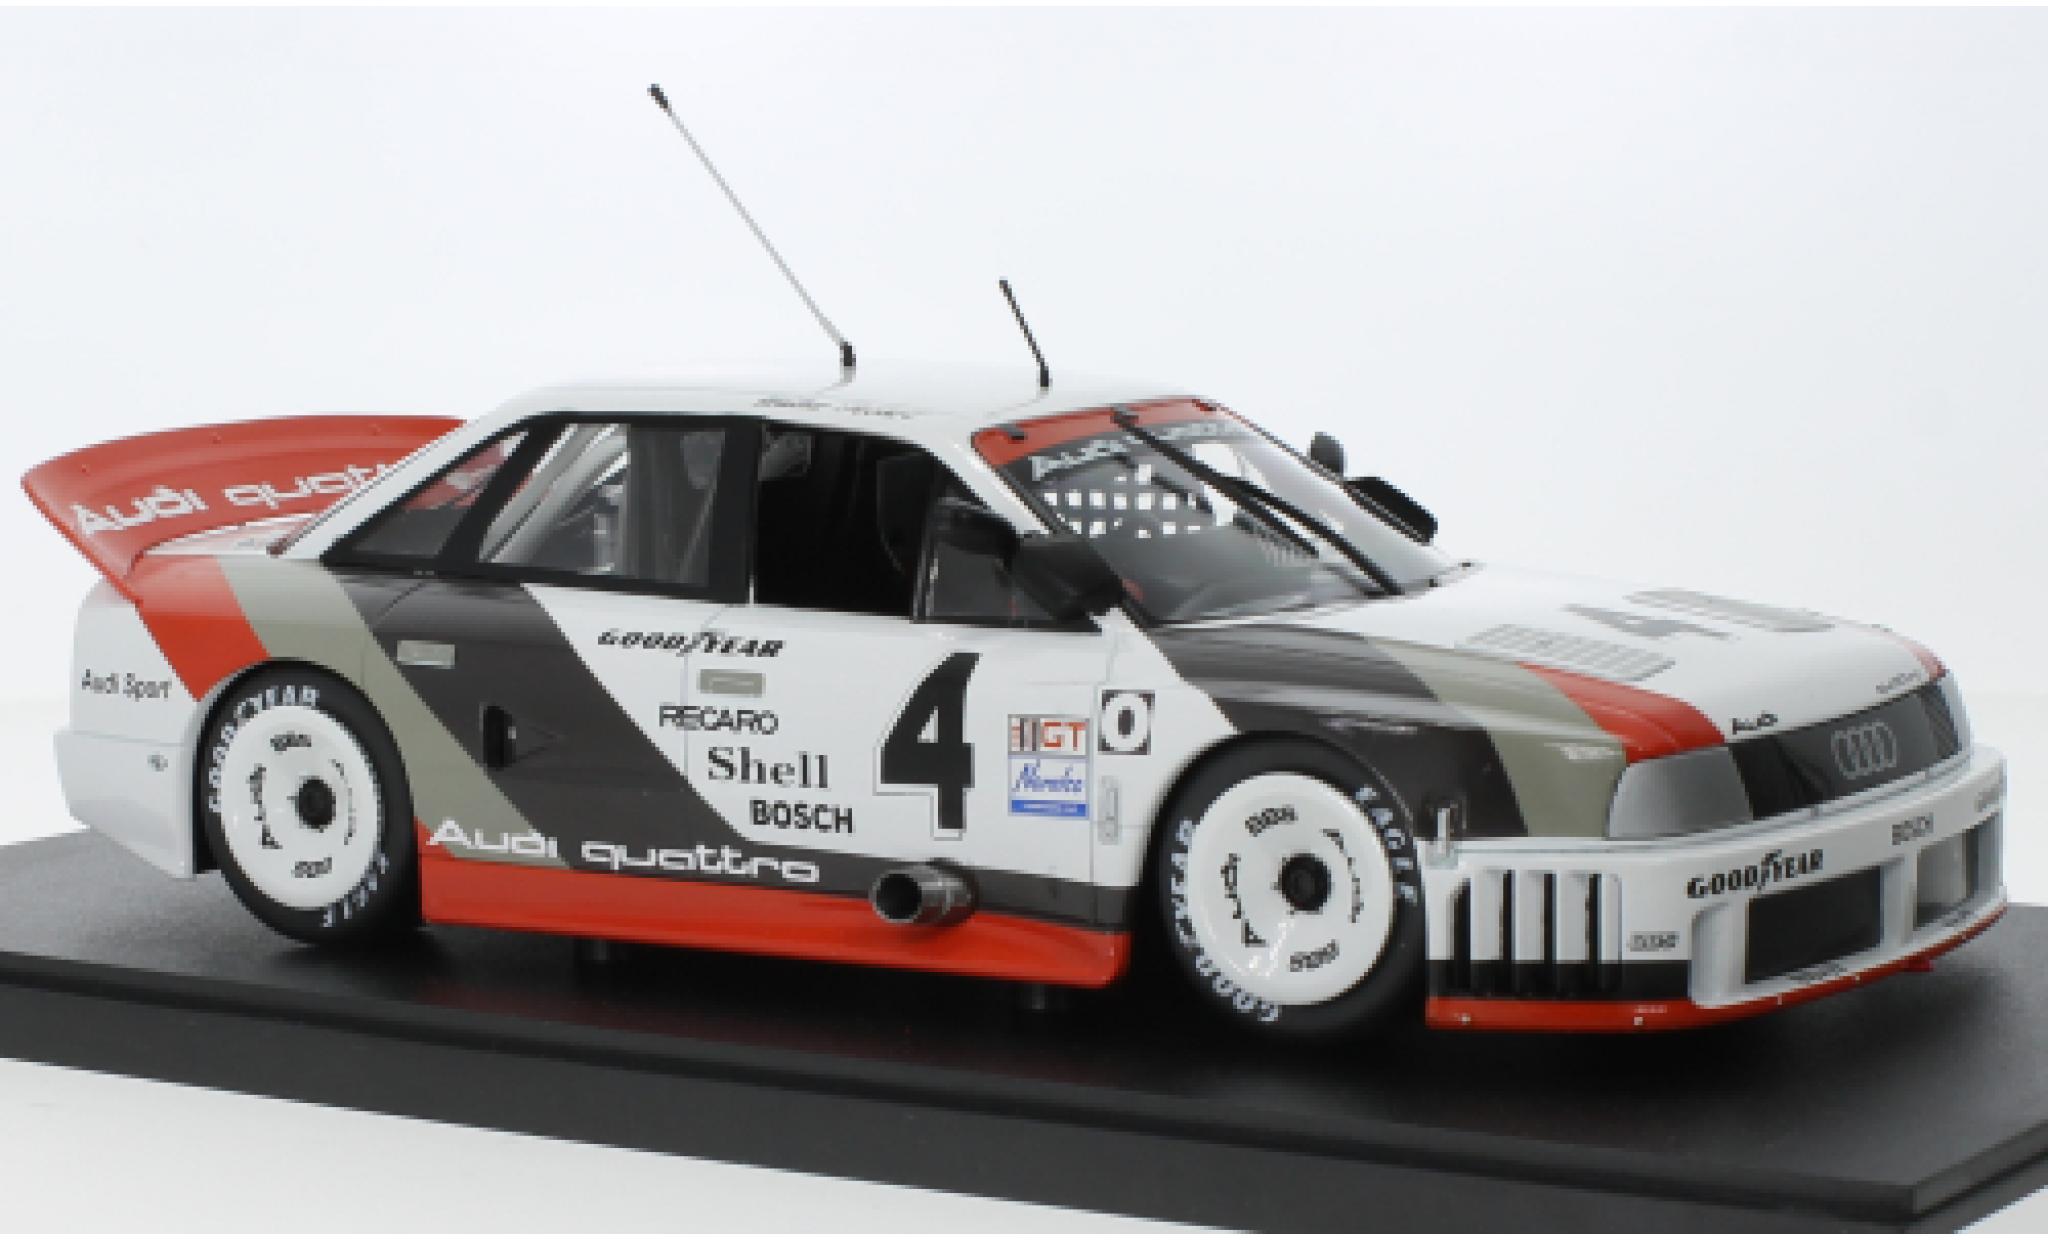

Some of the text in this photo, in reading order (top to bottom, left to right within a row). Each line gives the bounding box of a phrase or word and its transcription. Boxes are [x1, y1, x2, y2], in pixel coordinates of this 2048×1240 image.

[1030, 436, 1129, 481] Audi
[70, 485, 208, 537] Audi
[597, 628, 785, 658] GOODYEAR
[81, 668, 171, 702] Audi Sport
[658, 702, 778, 736] RECARO
[878, 650, 980, 832] 4
[1039, 720, 1089, 752] GT
[707, 744, 829, 789] Shell
[749, 798, 854, 834] BOSCH
[426, 817, 821, 883] Audi quattro
[1686, 848, 1824, 899] GOODYEAR
